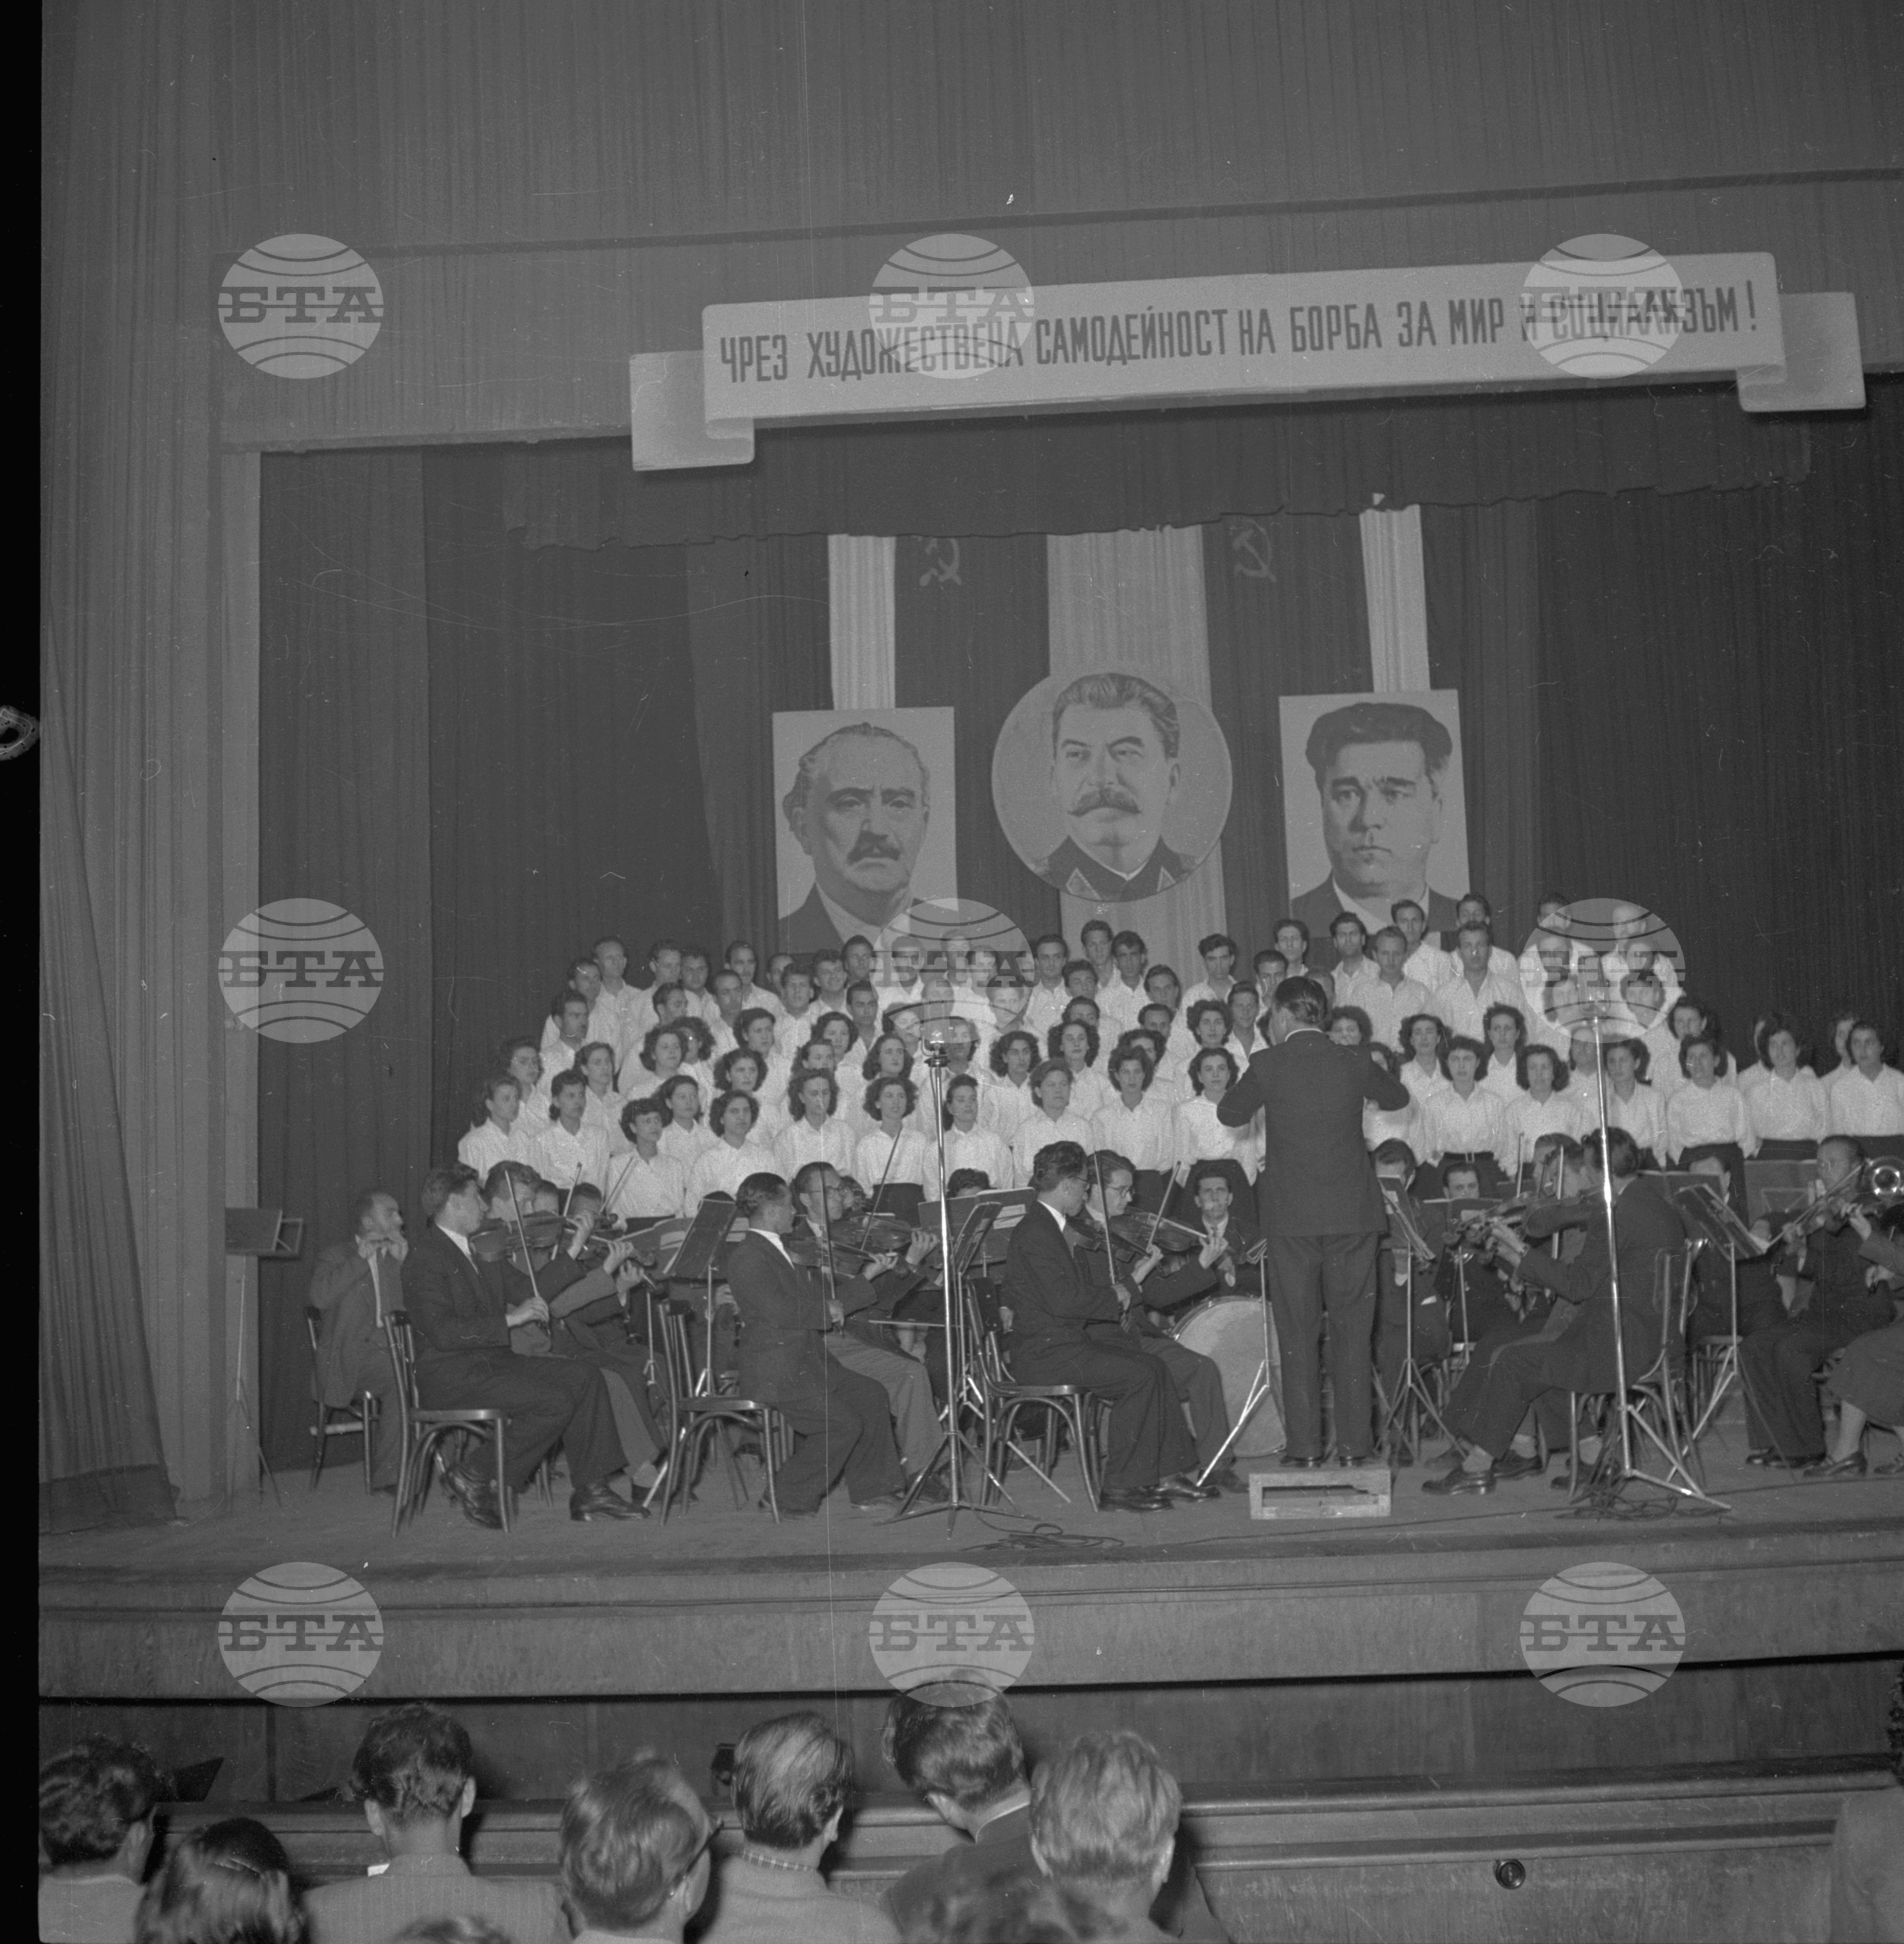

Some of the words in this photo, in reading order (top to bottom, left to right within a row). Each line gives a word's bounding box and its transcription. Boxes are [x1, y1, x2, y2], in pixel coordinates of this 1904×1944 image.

[721, 334, 788, 382] ЧРЕЗ
[806, 321, 1024, 381] ХУДОЖЕСТВЕНА
[1035, 306, 1228, 365] САМОДЕЙНОСТ
[1239, 309, 1276, 355] НА
[1290, 303, 1382, 352] БОРБА
[1397, 301, 1436, 347] ЗА
[1448, 297, 1504, 345] МИР
